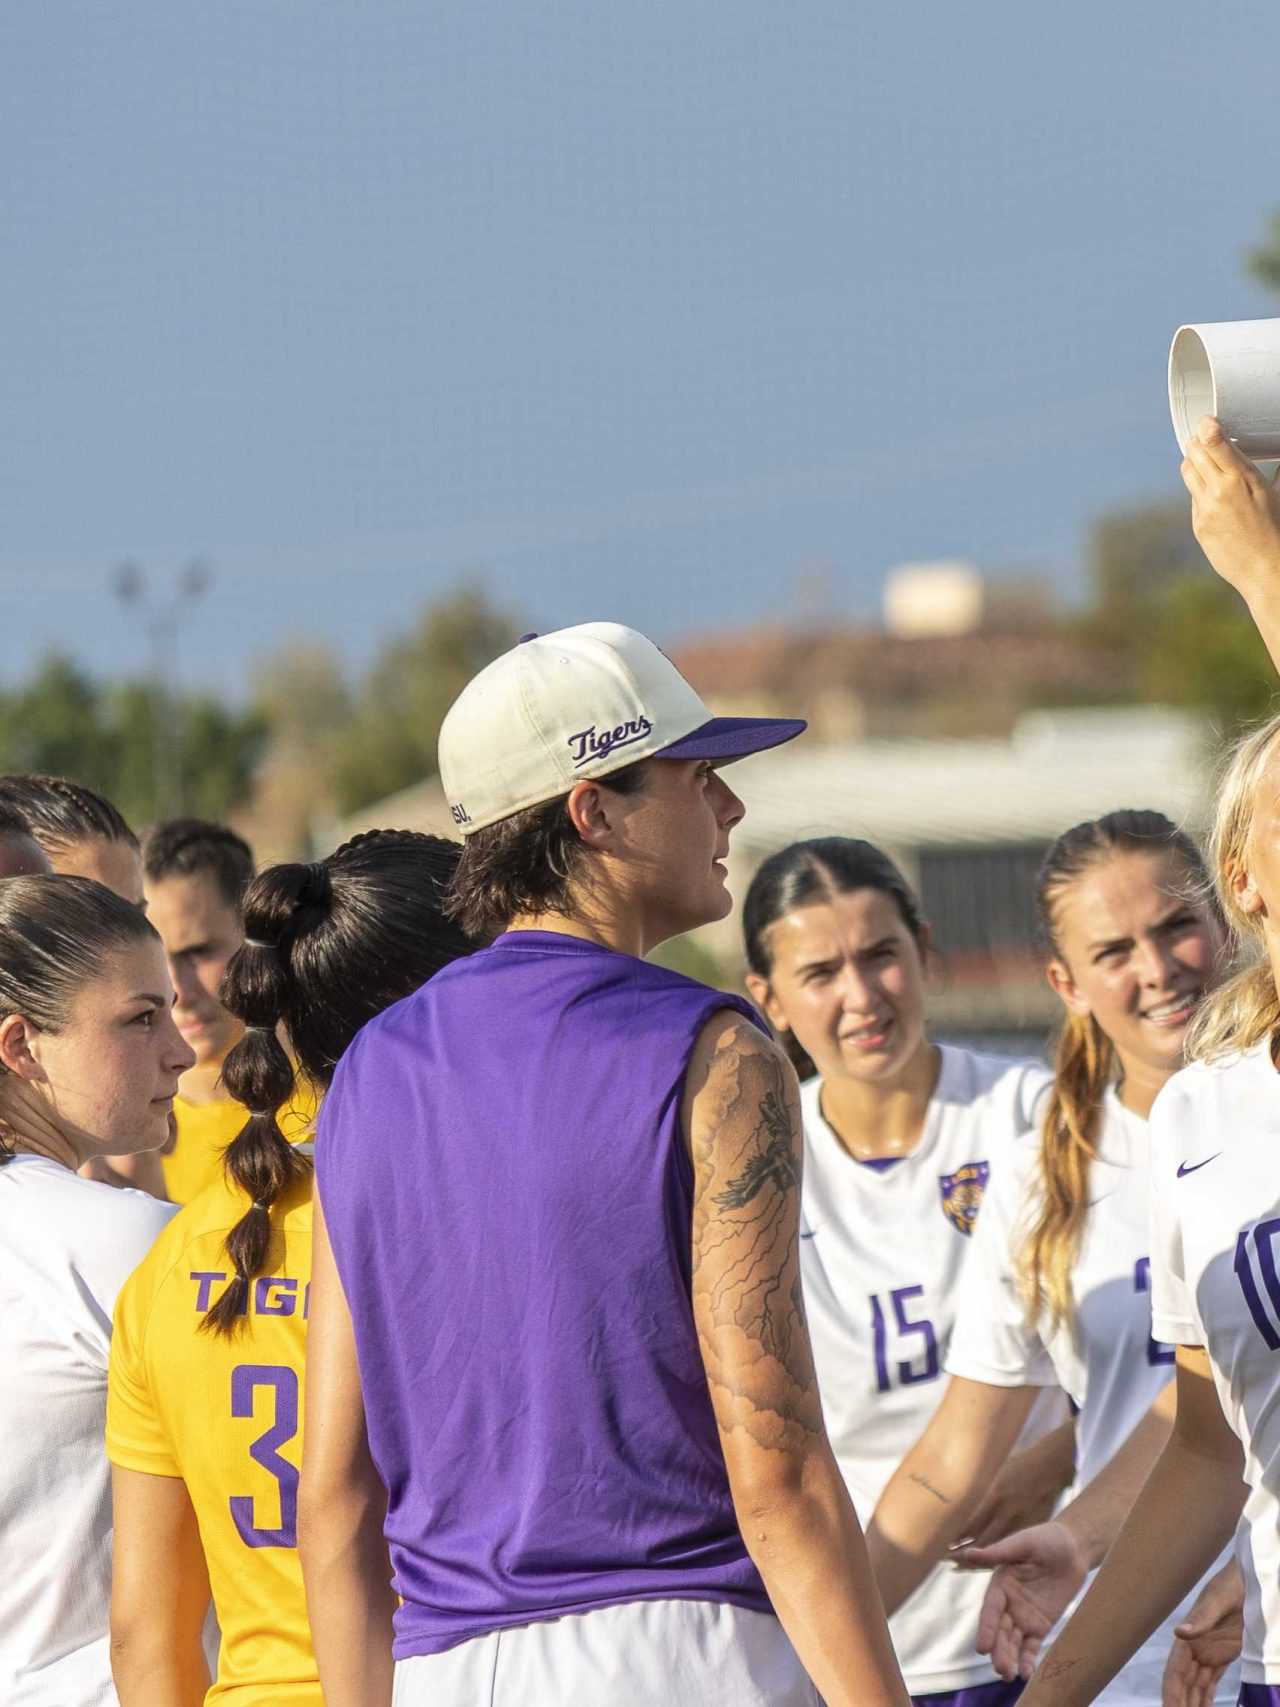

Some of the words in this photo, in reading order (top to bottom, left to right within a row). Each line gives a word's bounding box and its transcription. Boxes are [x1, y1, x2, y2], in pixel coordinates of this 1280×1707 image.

[568, 715, 653, 768] Tigers
[190, 1272, 311, 1320] TIG
[868, 1284, 939, 1394] 15
[230, 1365, 299, 1548] 3
